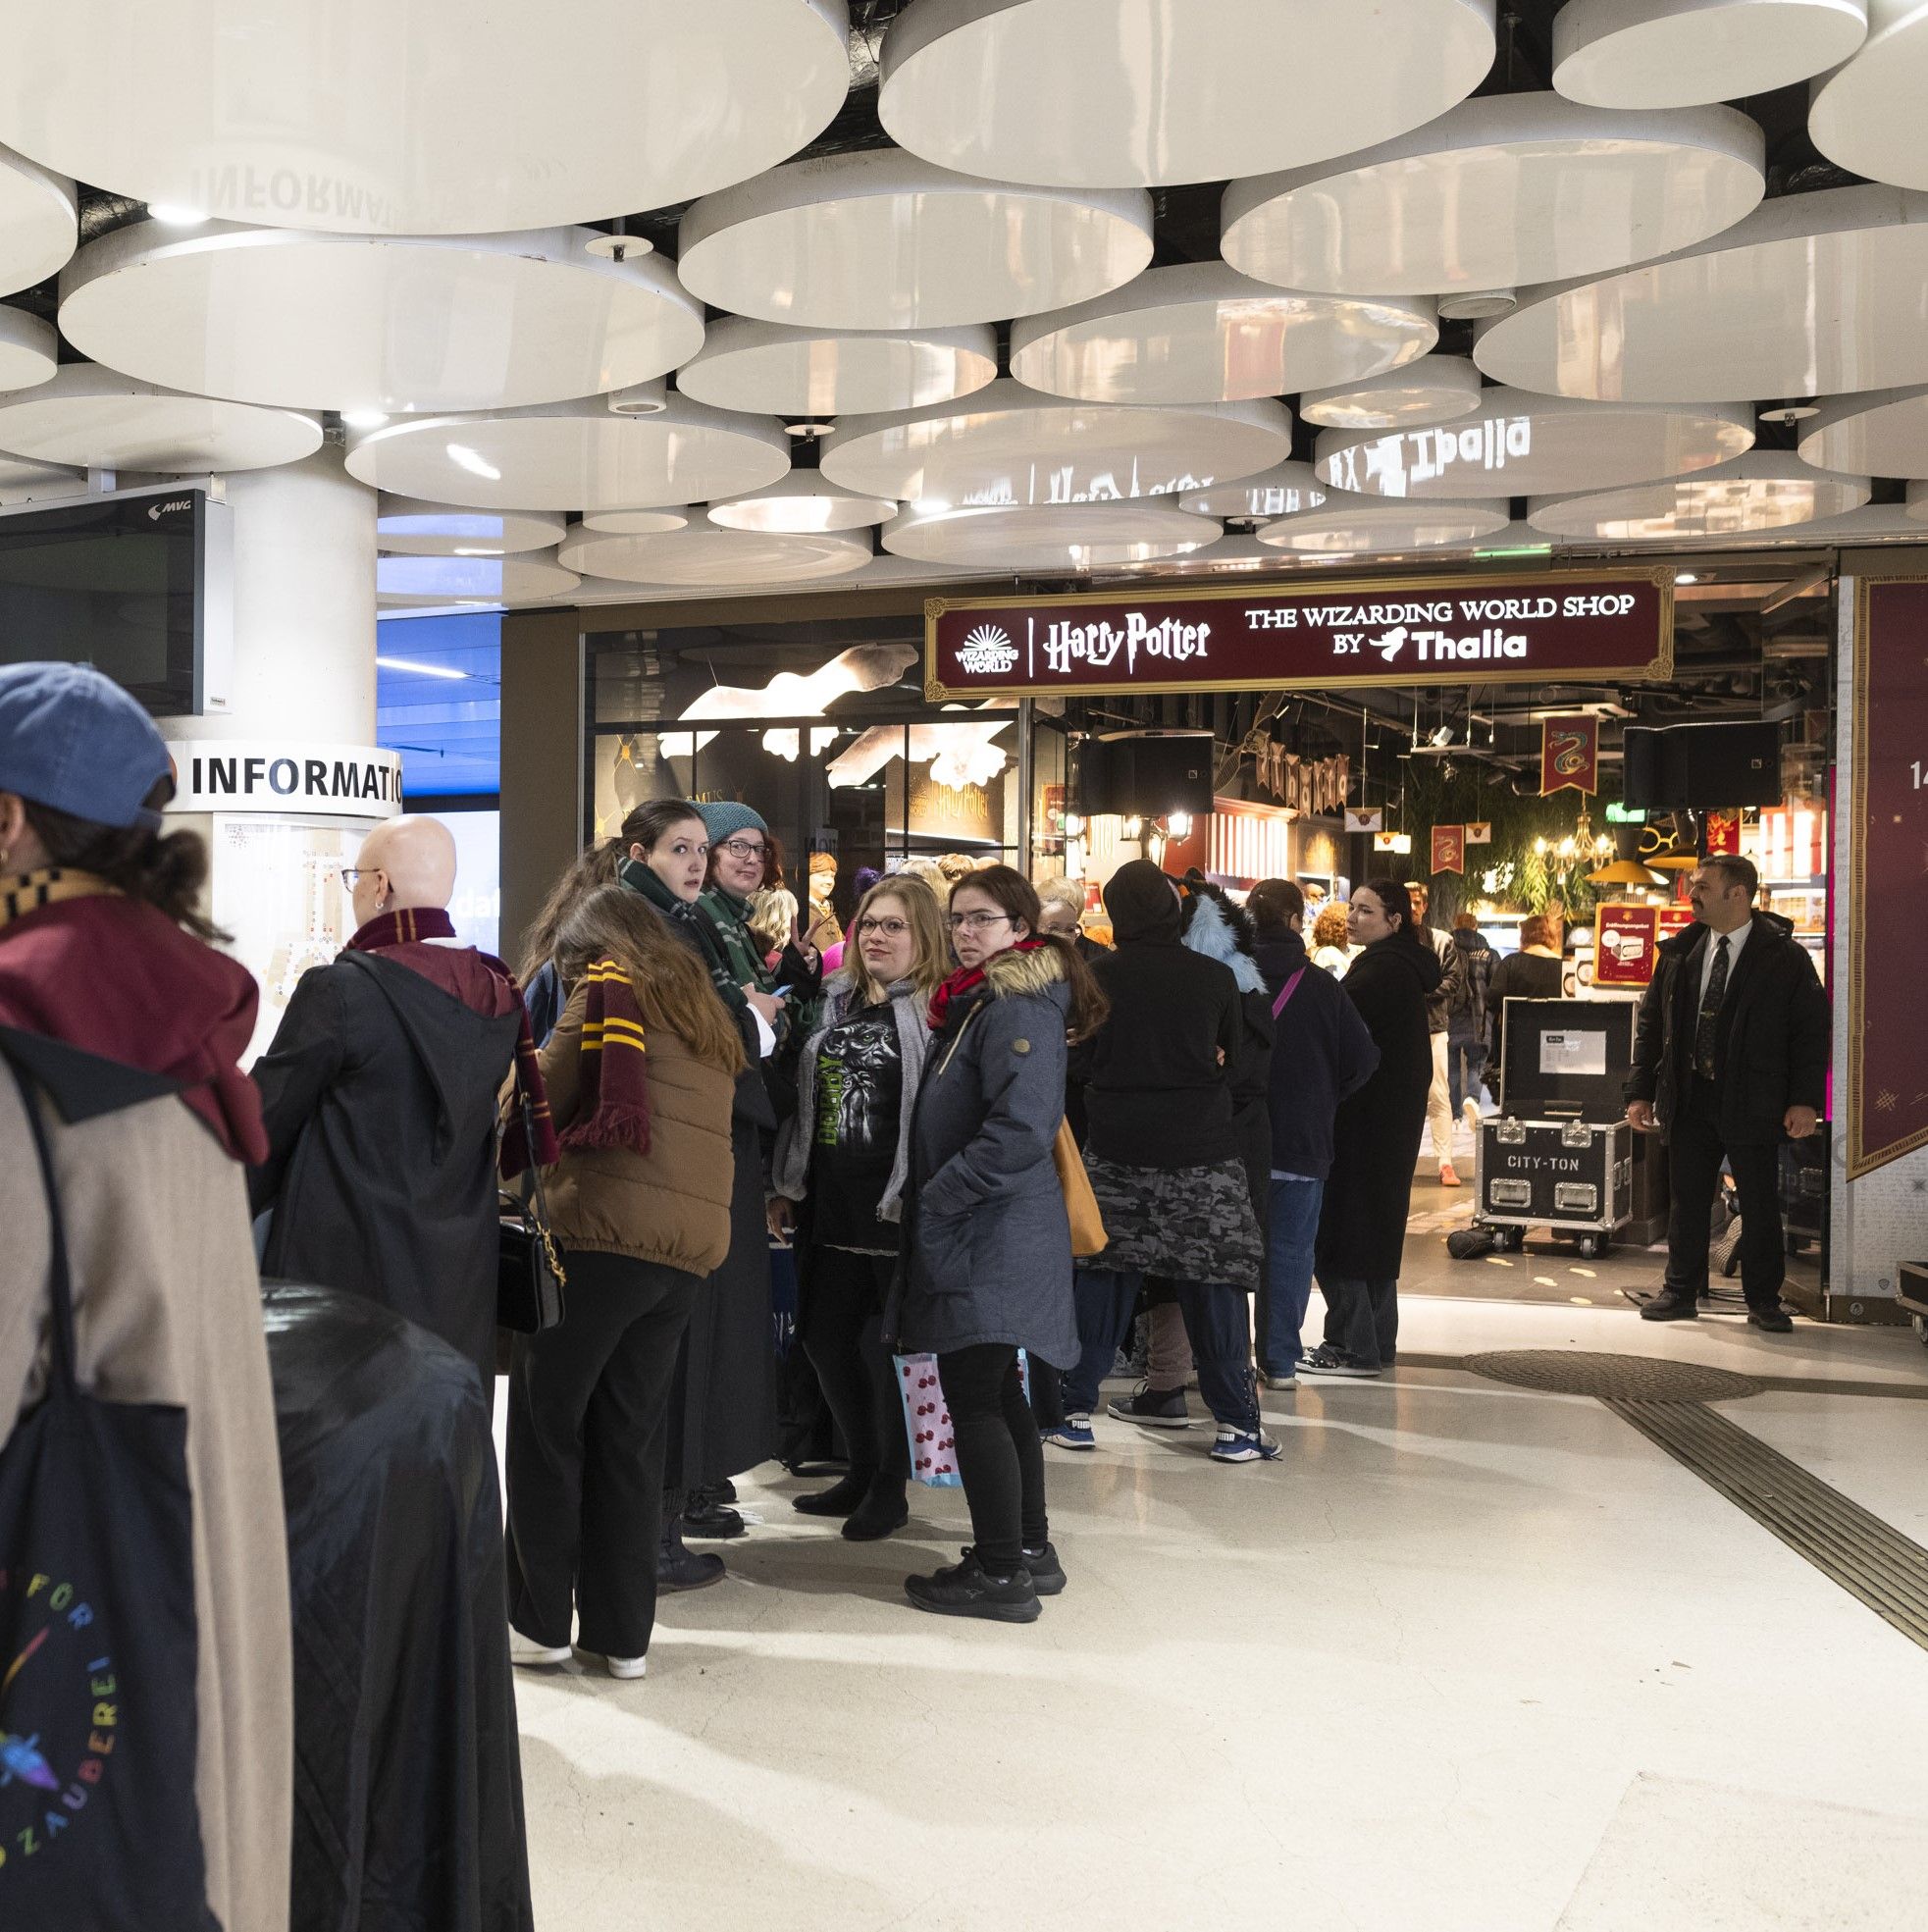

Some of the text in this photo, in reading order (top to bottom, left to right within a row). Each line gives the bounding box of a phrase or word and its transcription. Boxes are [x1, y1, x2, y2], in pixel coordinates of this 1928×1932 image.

[162, 499, 191, 513] MVG
[1245, 594, 1636, 630] THE WIZARDING WORLD SHOP
[955, 649, 1019, 663] WIZARDING
[1043, 612, 1211, 675] Harry Potter
[1332, 628, 1528, 661] BY Thalia
[963, 658, 1013, 674] WORLD
[192, 757, 402, 805] INFORMATIO
[1507, 1154, 1580, 1172] CITY-TON
[27, 1573, 95, 1630] FOR
